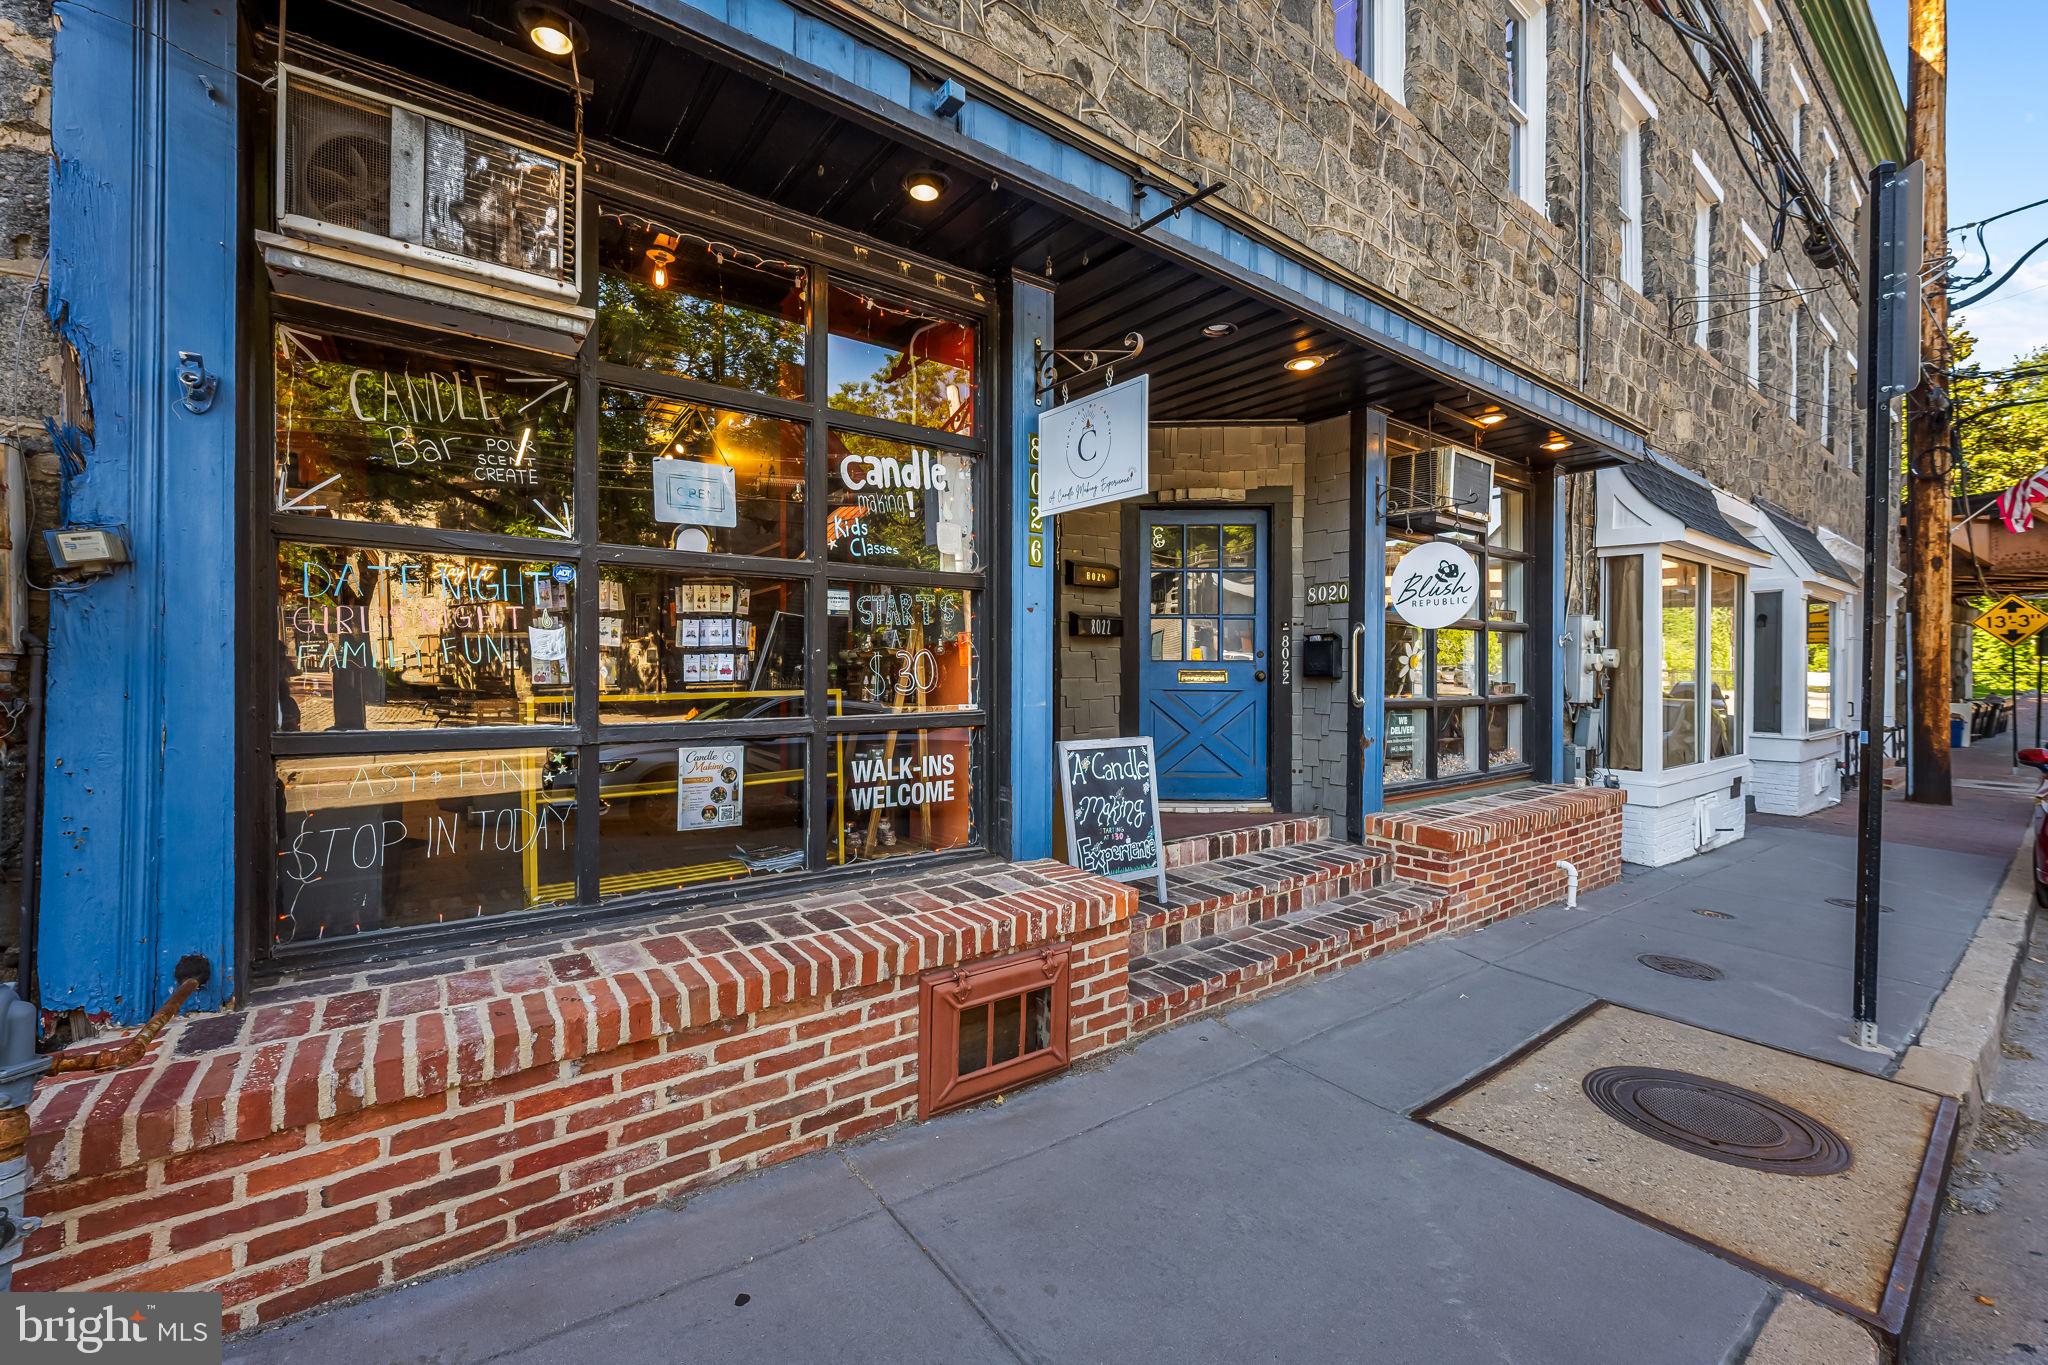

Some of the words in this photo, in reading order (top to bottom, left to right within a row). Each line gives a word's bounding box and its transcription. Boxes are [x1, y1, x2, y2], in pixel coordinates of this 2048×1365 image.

[350, 369, 500, 423] CANDLE
[385, 426, 462, 468] Bar
[485, 438, 537, 452] POUR
[474, 468, 539, 485] CREATE
[840, 449, 947, 491] Candle
[834, 514, 868, 540] Kids
[850, 537, 900, 557] Classes
[440, 566, 549, 606] NIGHT
[556, 569, 573, 577] ADT
[1086, 571, 1106, 582] 8024
[1308, 584, 1348, 603] 8020
[1396, 571, 1473, 606] Blush
[1411, 595, 1468, 608] REPUBLIC
[420, 605, 524, 632] NIGHT
[857, 594, 955, 626] STARTS
[1091, 619, 1111, 635] 8022
[297, 638, 424, 670] FAMILY
[441, 632, 504, 665] FUN
[686, 750, 718, 764] Candle
[688, 761, 723, 774] Making
[851, 754, 955, 784] WALK-INS
[1072, 753, 1088, 785] A
[1092, 749, 1150, 781] Candle
[460, 758, 526, 789] FUN
[851, 779, 955, 811] WELCOME
[286, 820, 408, 880] STOP
[427, 813, 458, 858] IN
[471, 802, 574, 854] TODAY
